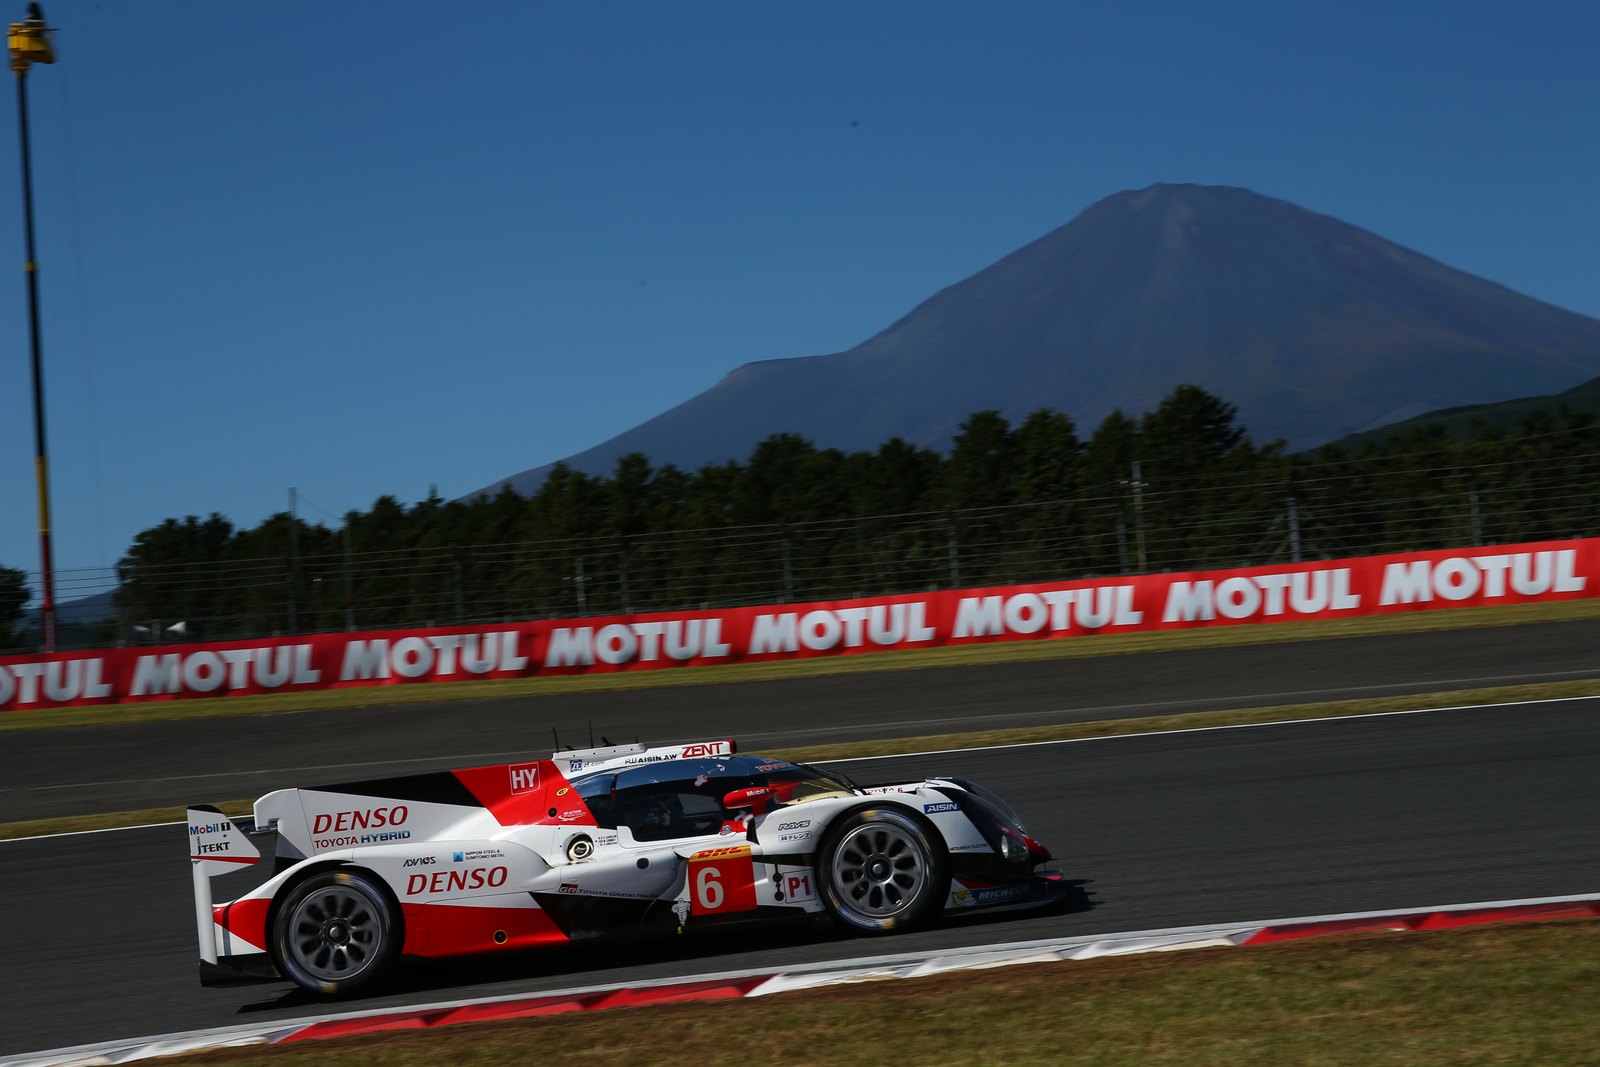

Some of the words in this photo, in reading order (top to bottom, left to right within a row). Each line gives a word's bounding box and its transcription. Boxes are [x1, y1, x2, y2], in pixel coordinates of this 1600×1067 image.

[1379, 550, 1586, 605] MOTUL
[1162, 568, 1360, 622] MOTUL
[952, 585, 1142, 637] MOTUL
[748, 602, 935, 654] MOTUL
[545, 618, 730, 667] MOTUL
[340, 631, 528, 681] MOTUL
[130, 644, 321, 696] MOTUL
[638, 755, 662, 763] AISIN
[682, 742, 723, 758] ZENT
[511, 768, 537, 790] HY
[746, 789, 764, 797] Mobil
[312, 805, 408, 834] DENSO
[927, 803, 958, 813] AISIN
[190, 823, 219, 836] Mobil
[221, 822, 231, 832] 1
[778, 820, 811, 831] RAYS
[314, 836, 359, 849] TOYOTA
[360, 830, 411, 844] HYBRID
[697, 846, 743, 859] DHL
[406, 866, 508, 895] DENSO
[696, 867, 724, 909] 6
[788, 875, 810, 898] P1
